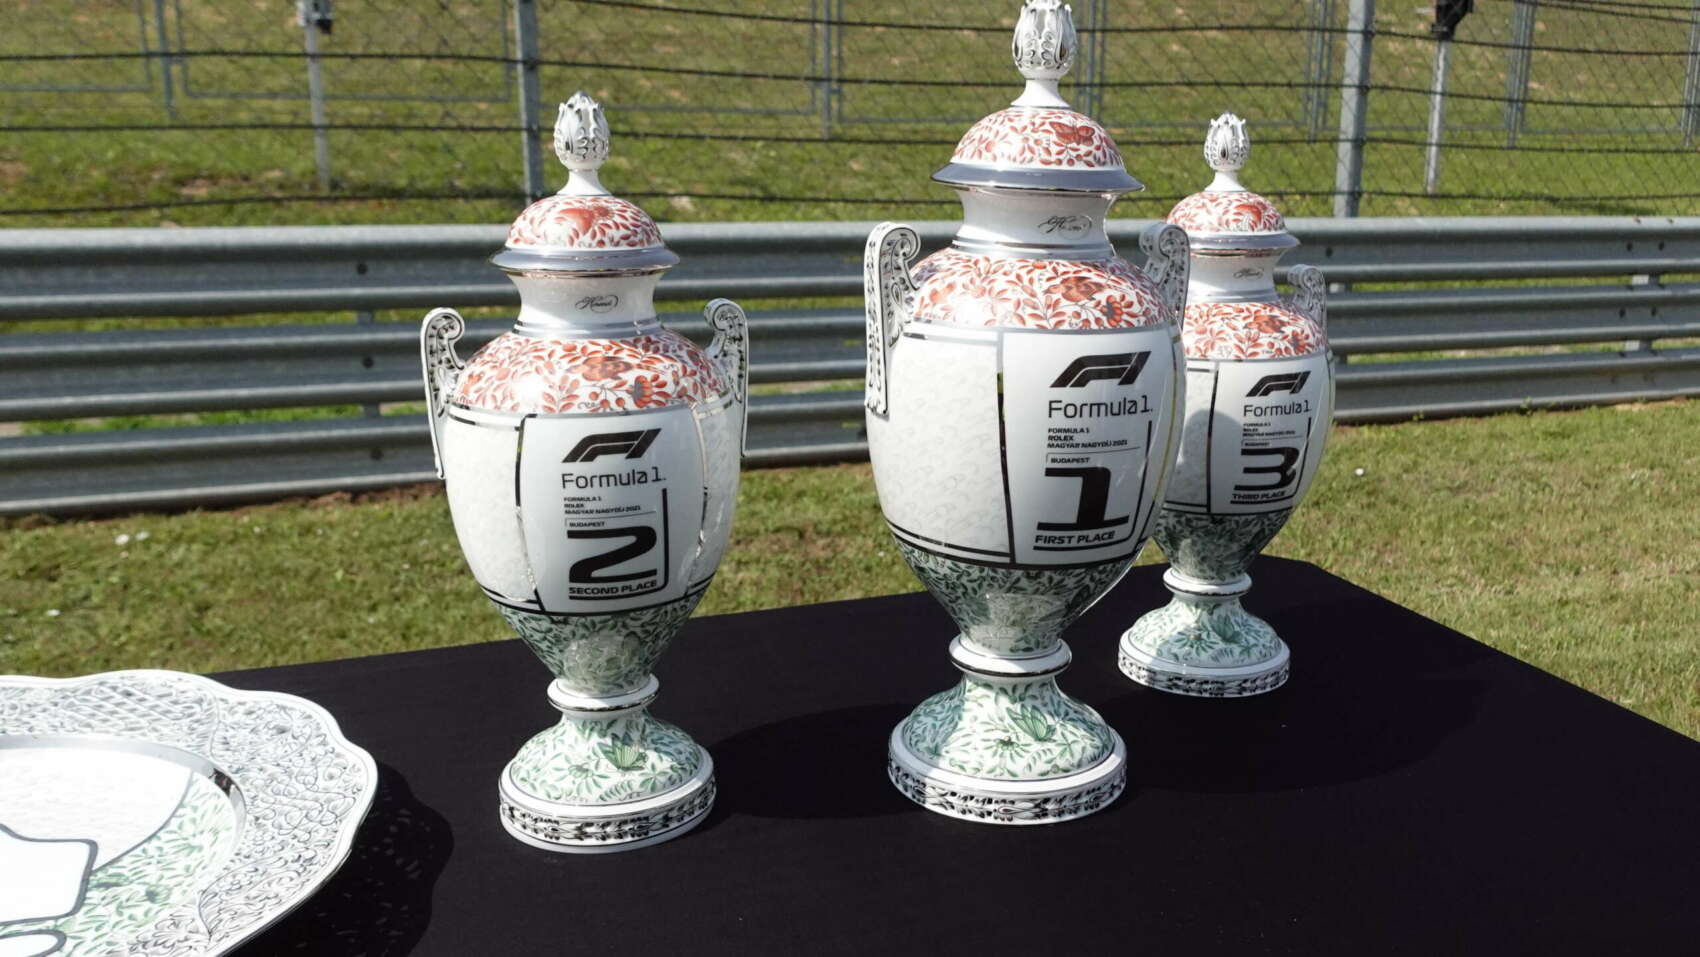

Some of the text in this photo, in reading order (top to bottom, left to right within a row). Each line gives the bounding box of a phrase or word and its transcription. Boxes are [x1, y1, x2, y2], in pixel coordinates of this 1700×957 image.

[1234, 447, 1299, 491] 3
[1037, 466, 1130, 531] 1
[567, 526, 657, 583] 2
[1035, 530, 1116, 545] FIRST PLACE
[569, 580, 657, 595] SECOND PLACE
